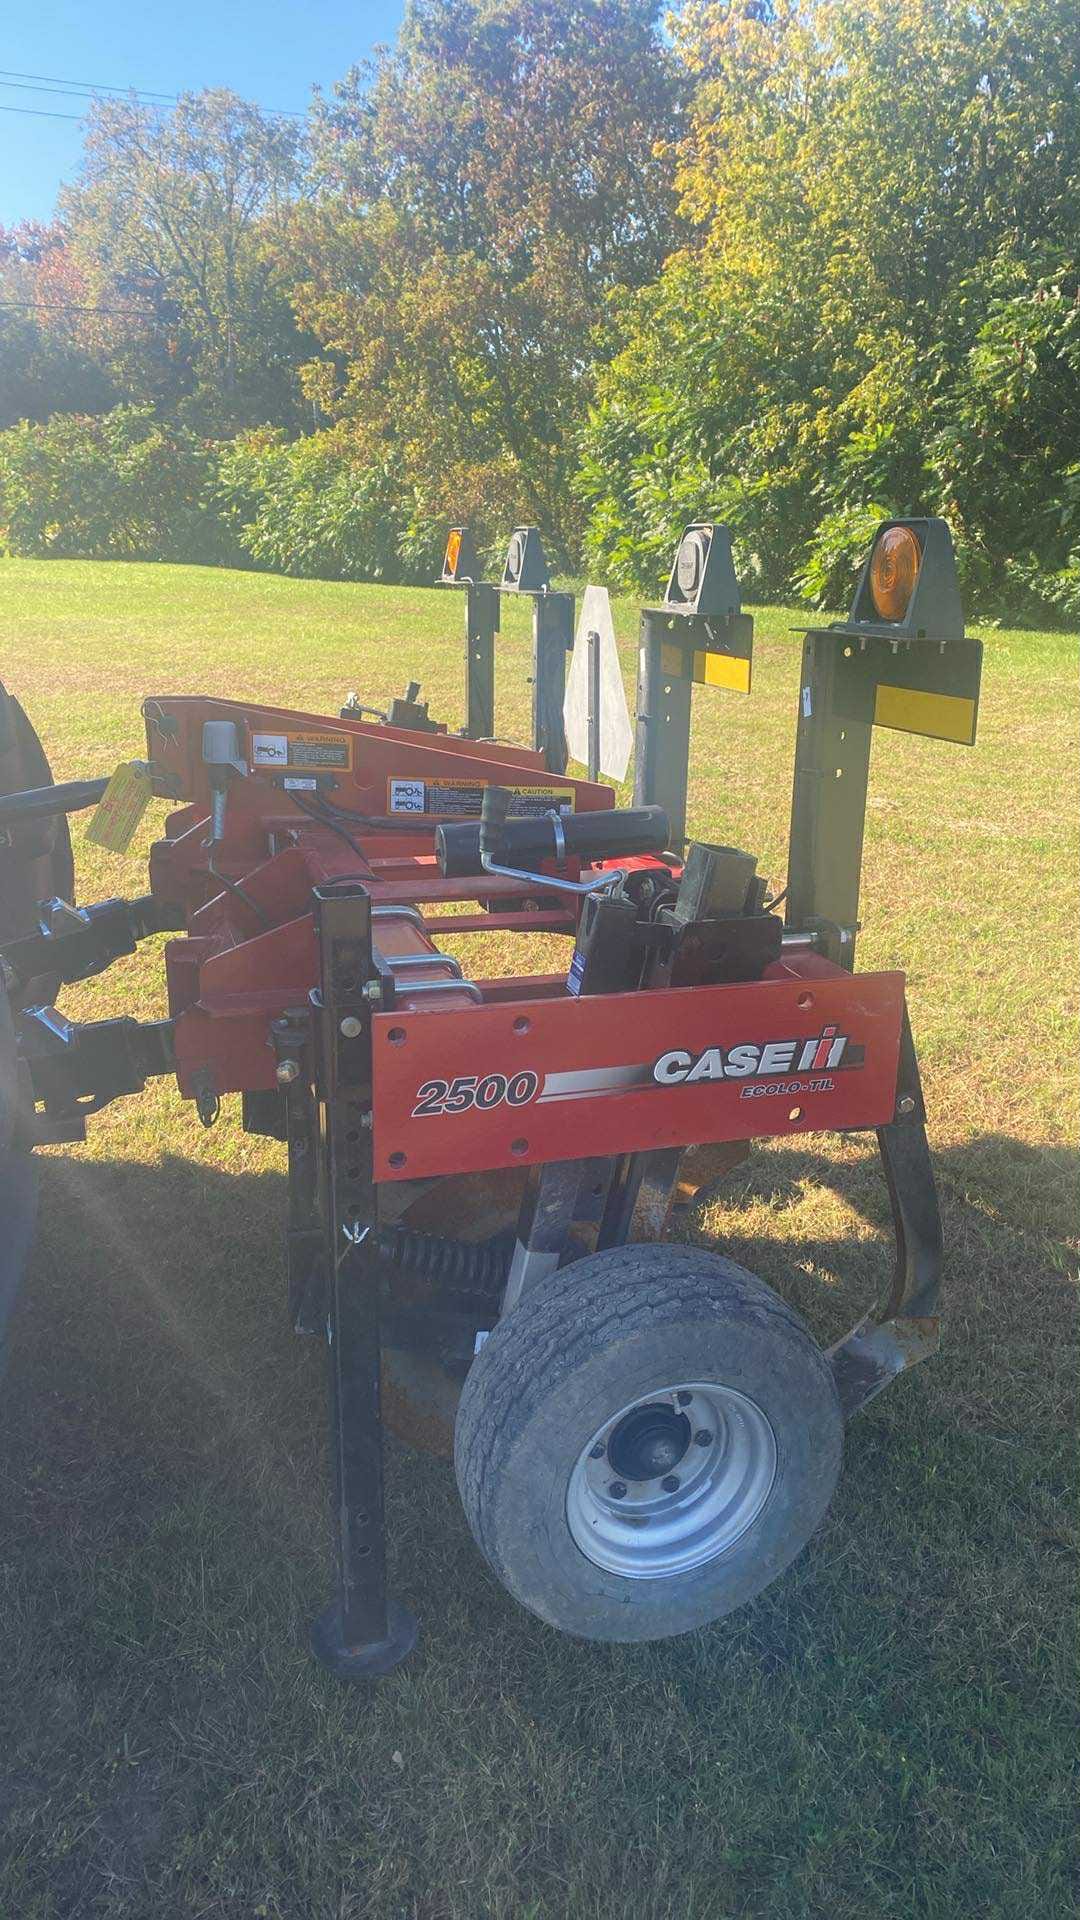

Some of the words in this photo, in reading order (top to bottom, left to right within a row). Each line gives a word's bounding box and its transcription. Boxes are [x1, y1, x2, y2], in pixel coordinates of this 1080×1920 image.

[307, 736, 345, 744] WARNING
[522, 788, 553, 796] CAUTION
[653, 1042, 797, 1084] CASE
[411, 1071, 538, 1118] 2500
[739, 1080, 836, 1099] ECOLO-TIL
